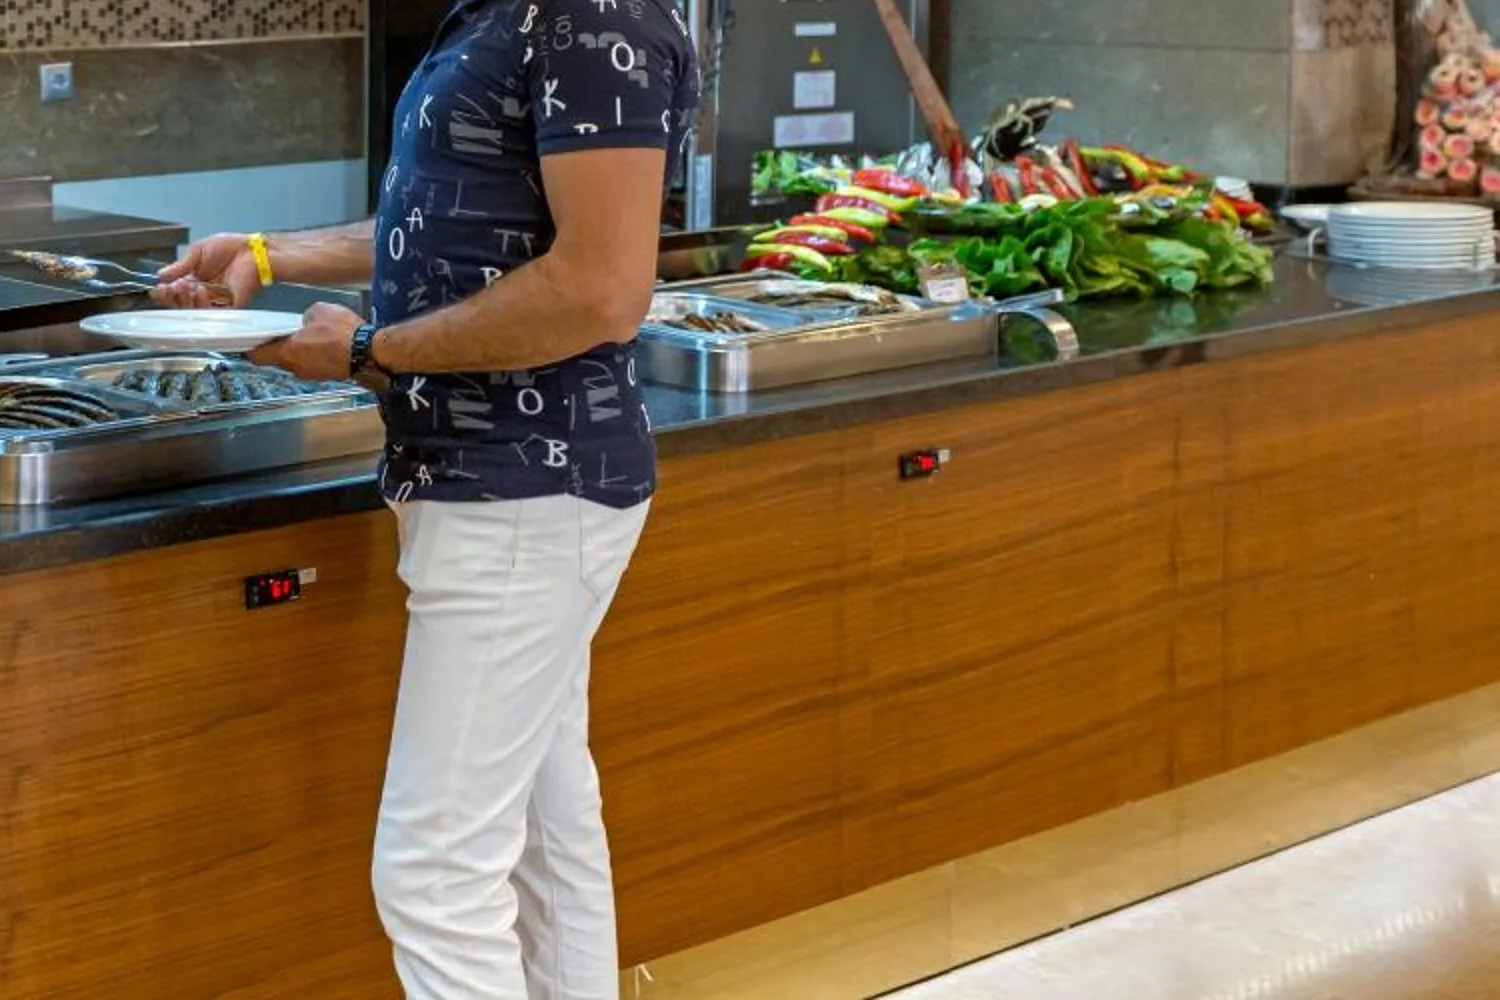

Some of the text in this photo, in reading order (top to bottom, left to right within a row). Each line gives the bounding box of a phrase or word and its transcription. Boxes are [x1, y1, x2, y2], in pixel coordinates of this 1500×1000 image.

[542, 78, 567, 118] K
[405, 207, 424, 233] A
[405, 375, 431, 411] K
[516, 387, 544, 416] O
[541, 439, 569, 468] B
[415, 463, 434, 487] A
